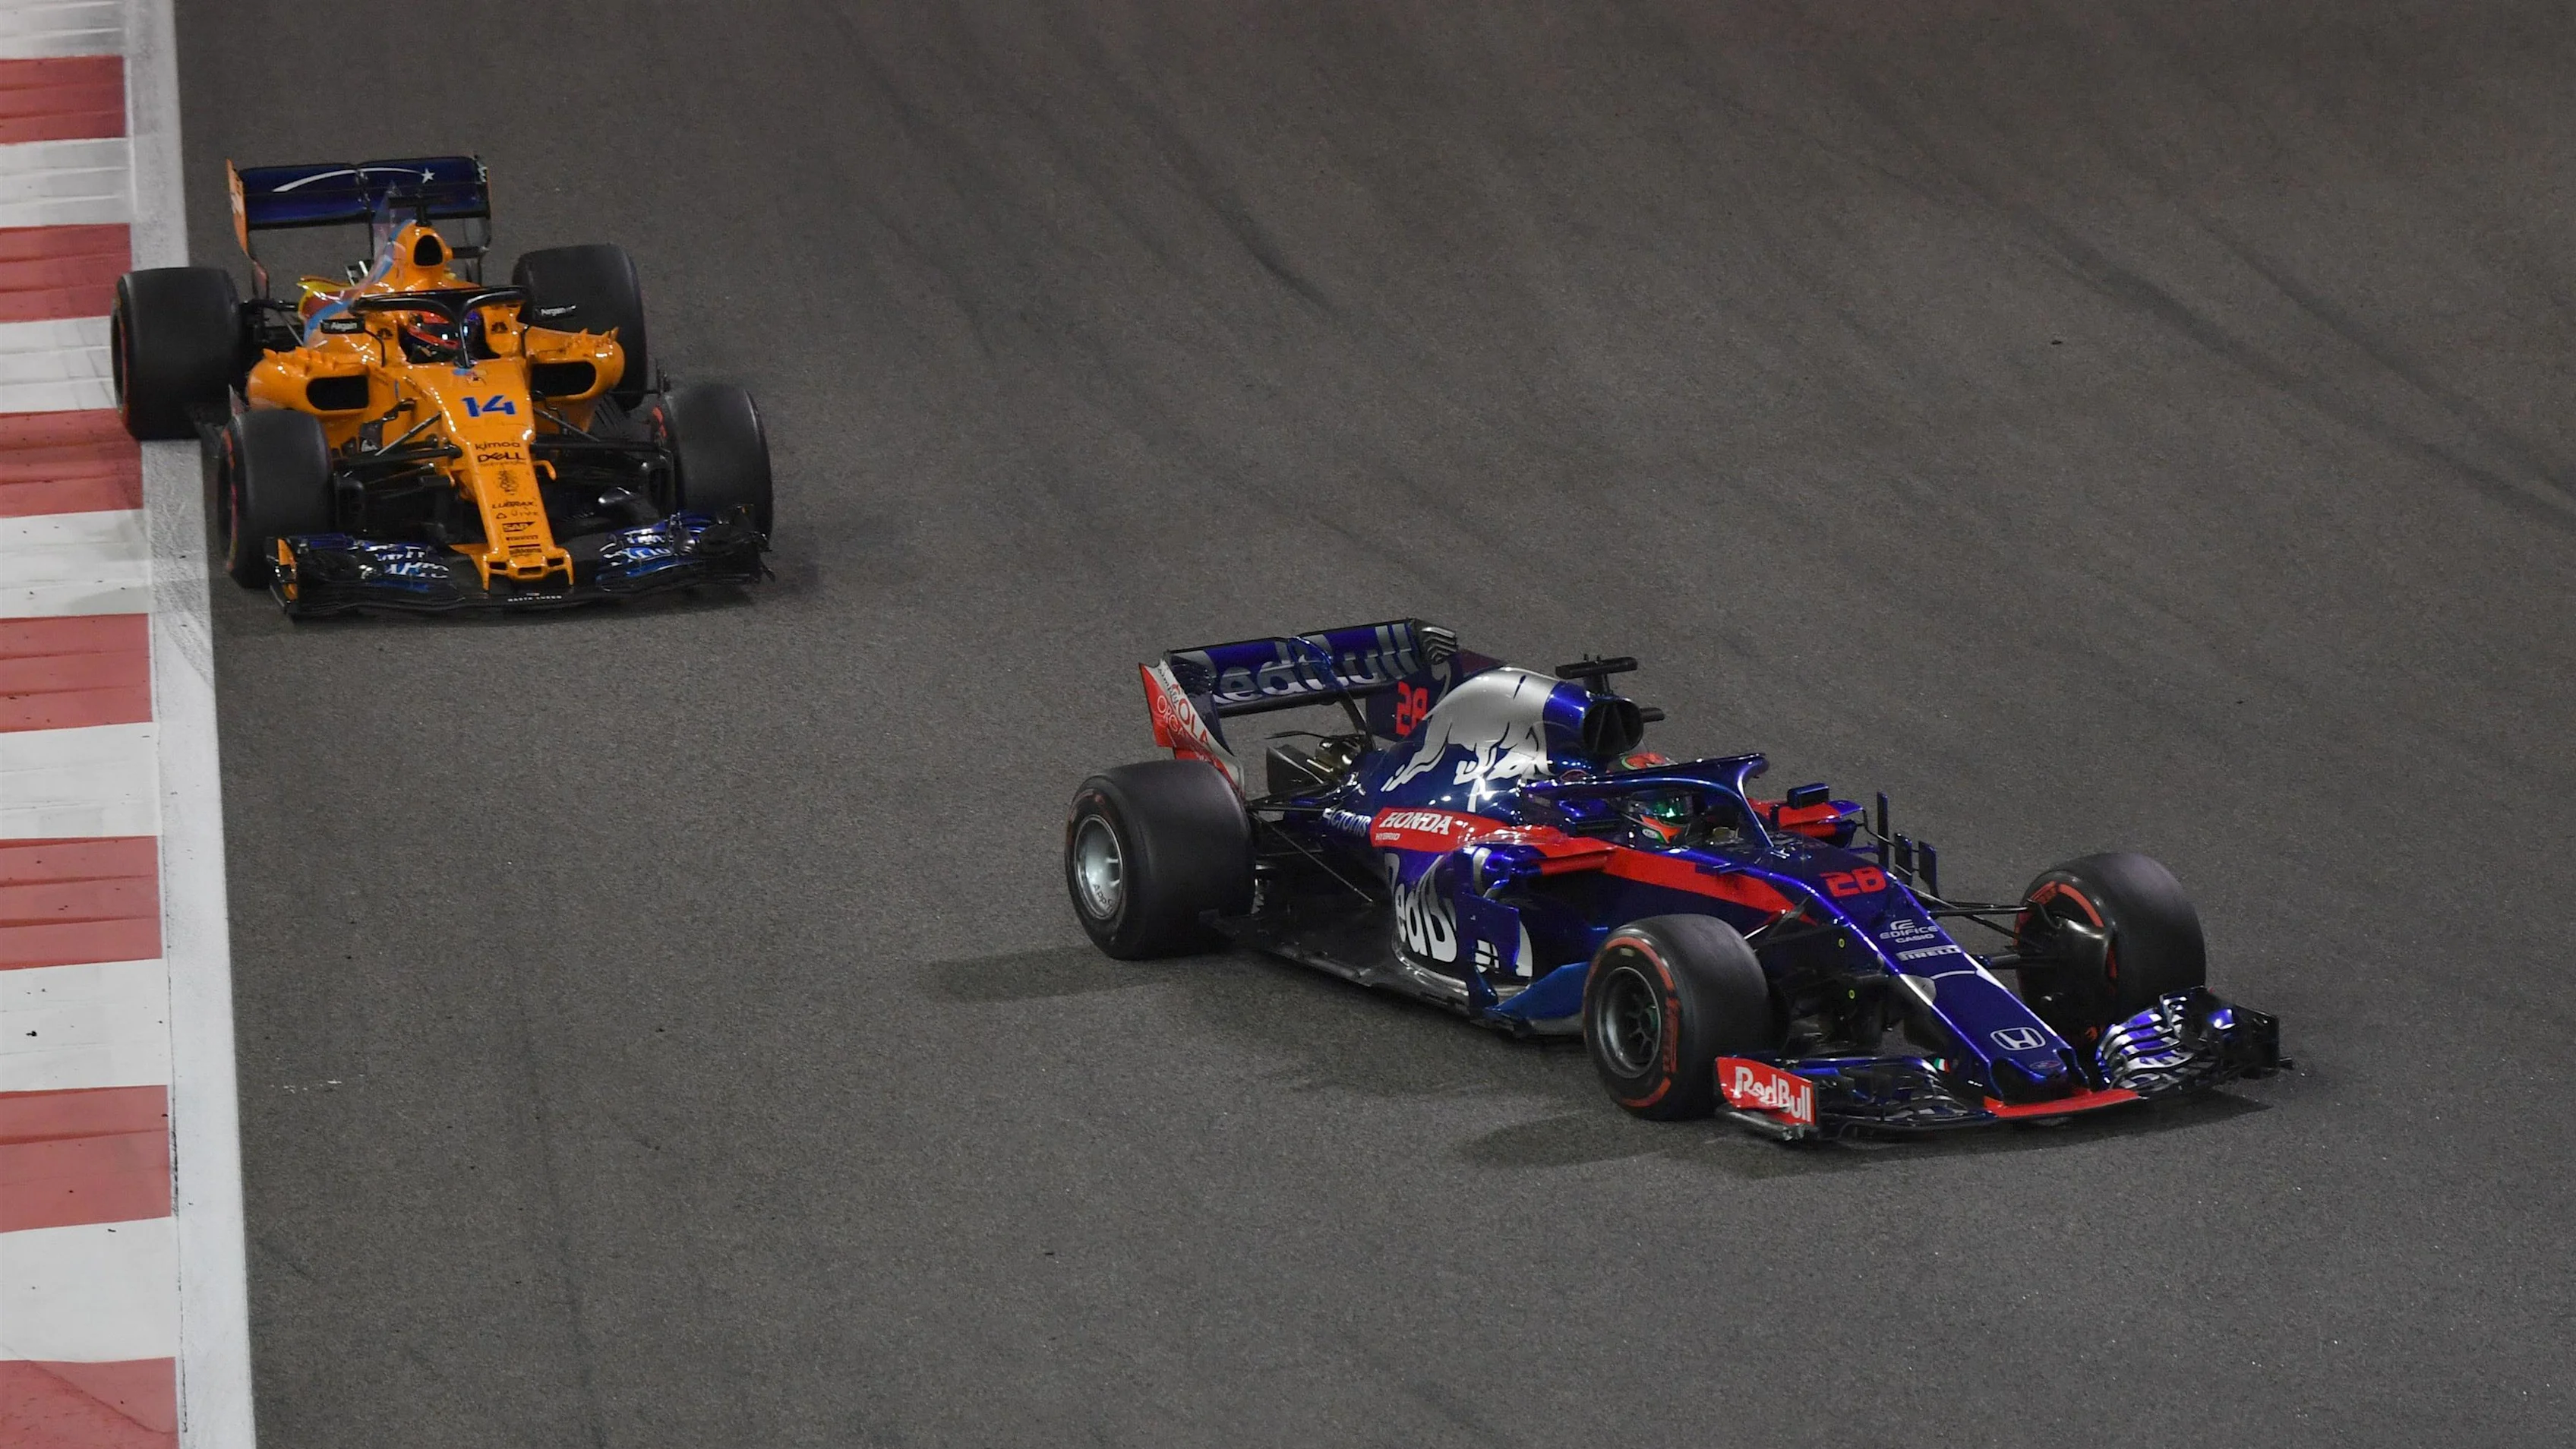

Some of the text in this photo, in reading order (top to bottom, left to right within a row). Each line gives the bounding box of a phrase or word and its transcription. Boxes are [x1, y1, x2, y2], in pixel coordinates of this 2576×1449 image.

[460, 394, 516, 418] 14
[477, 452, 527, 462] DELL
[1395, 680, 1428, 737] 28
[1378, 811, 1454, 835] HONDA
[1375, 832, 1401, 841] HYBRID
[1820, 865, 1887, 898] 28
[1879, 924, 1939, 939] EDIFICE
[1894, 933, 1935, 943] CASIO
[1896, 945, 1962, 961] PIRELLI
[1732, 1066, 1812, 1122] RedBull
